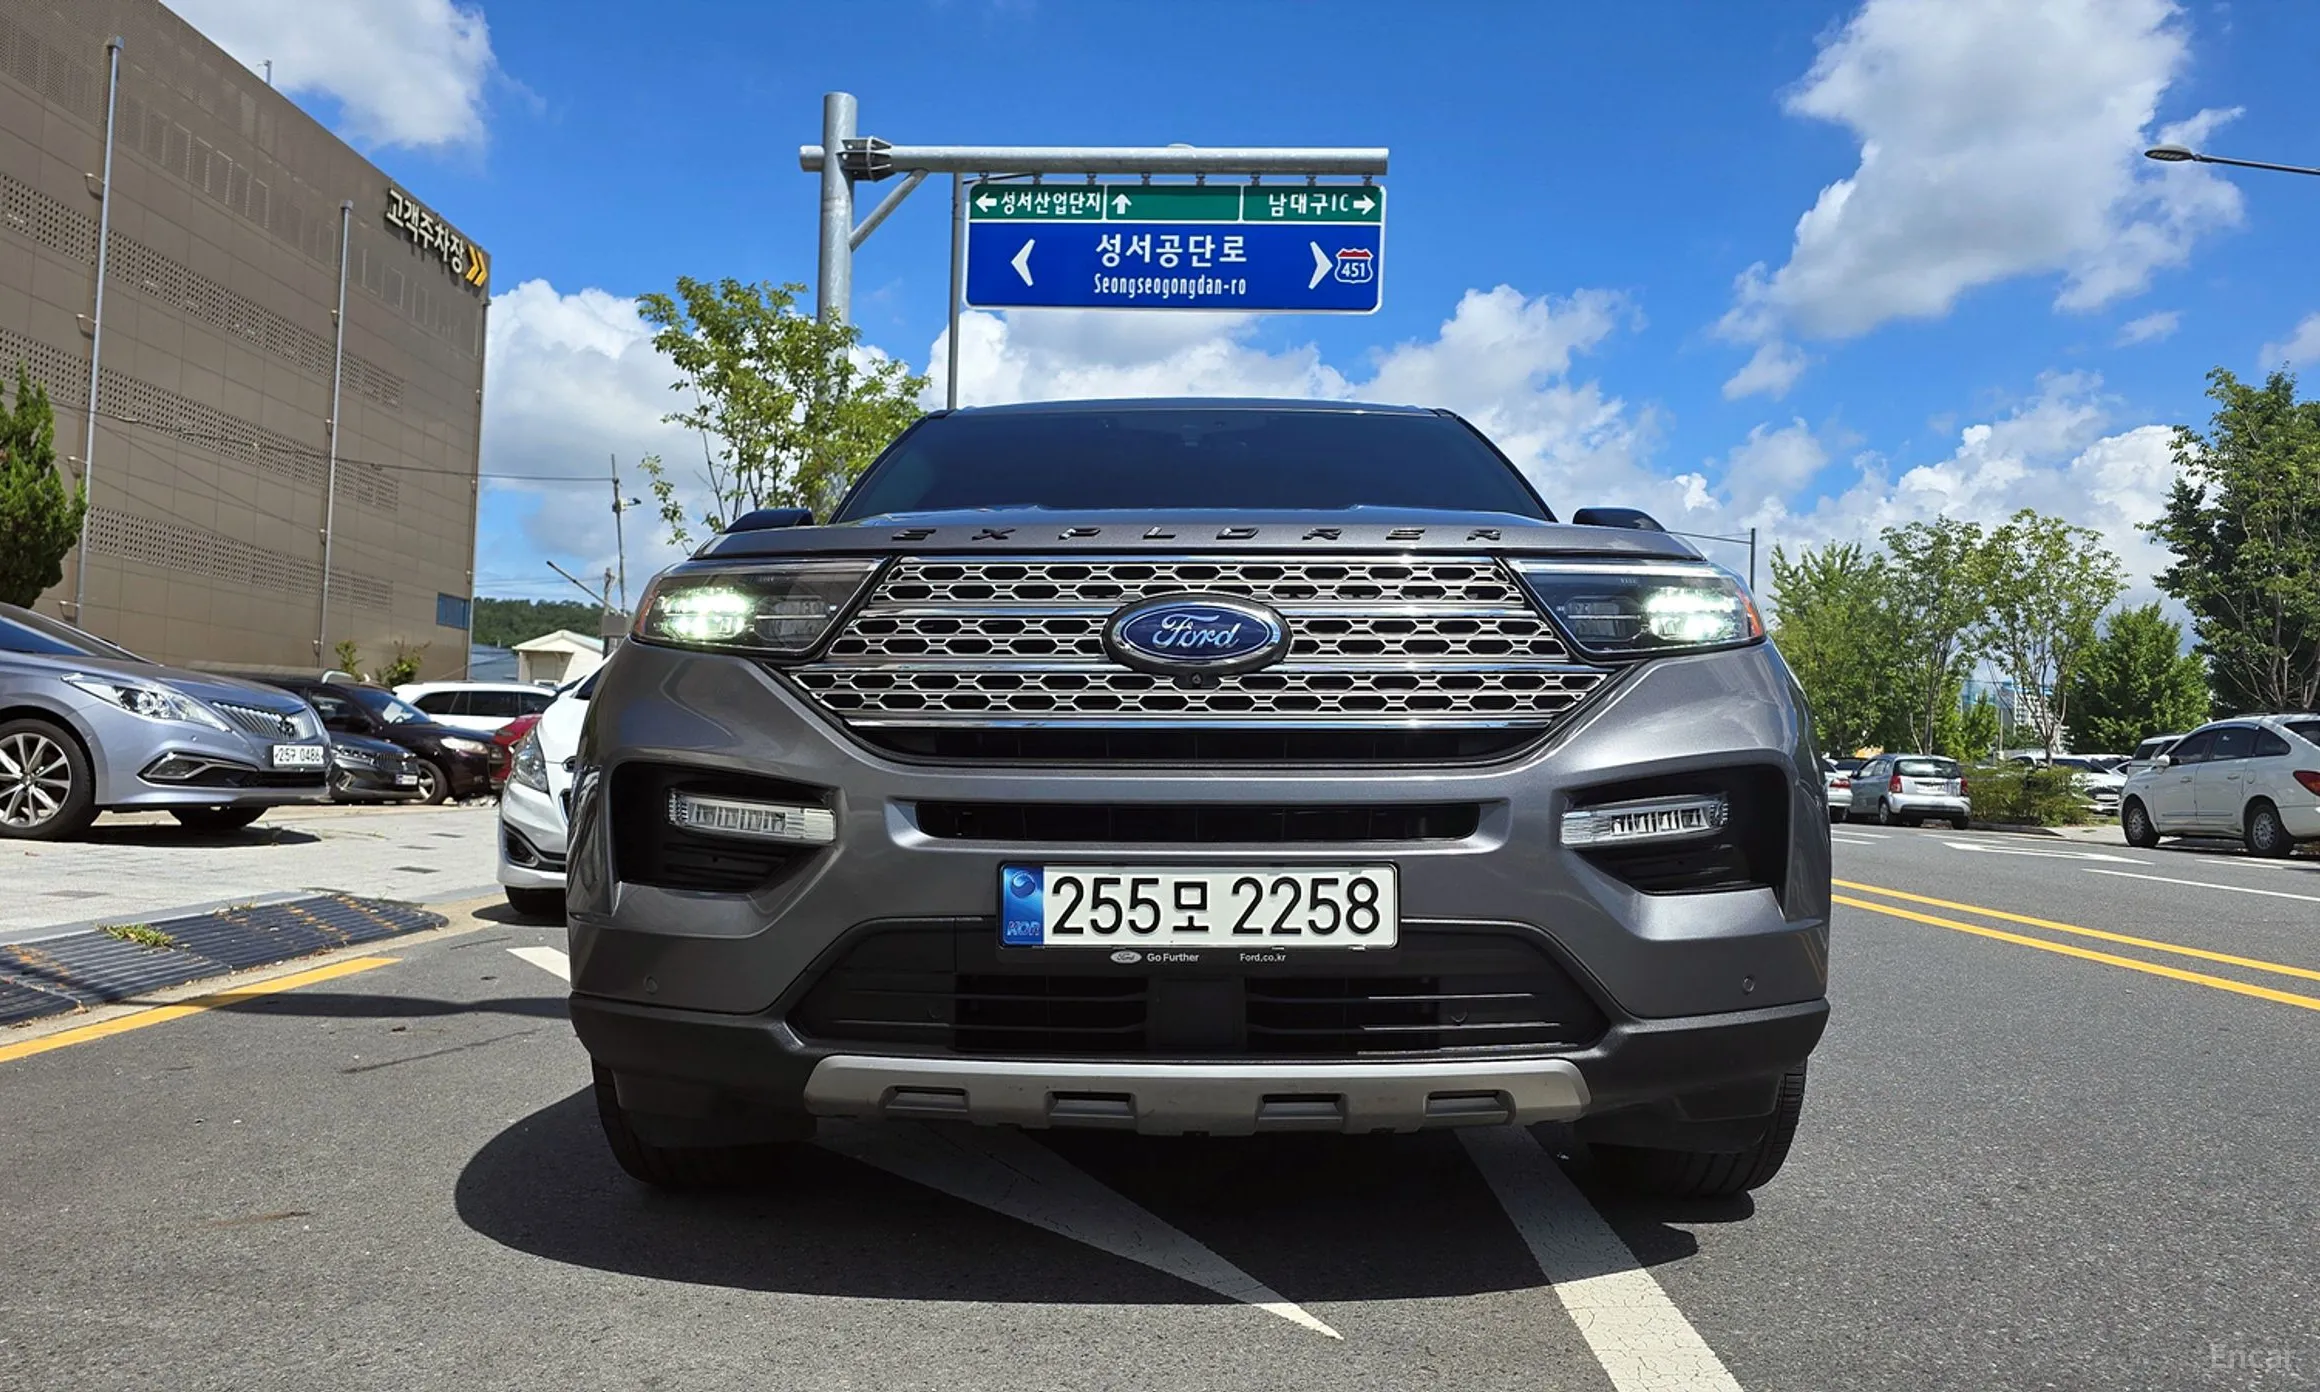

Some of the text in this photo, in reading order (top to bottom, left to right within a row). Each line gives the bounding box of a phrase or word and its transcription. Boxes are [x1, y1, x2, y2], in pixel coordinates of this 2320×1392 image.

[1000, 191, 1101, 215] 성서산업단지
[1268, 193, 1349, 217] 남대구IC
[386, 189, 465, 273] 고객주차장
[1095, 233, 1247, 268] 성서공단로
[1341, 262, 1366, 278] 451
[1094, 273, 1247, 299] Seongseogongdan-ro
[891, 528, 1501, 541] EXPLORER
[1152, 603, 1241, 649] Ford
[1051, 875, 1381, 935] 255모 2258
[1006, 920, 1041, 936] KOR
[1147, 953, 1161, 962] Go
[1163, 953, 1200, 962] Further
[1239, 953, 1287, 963] Ford.co.kr
